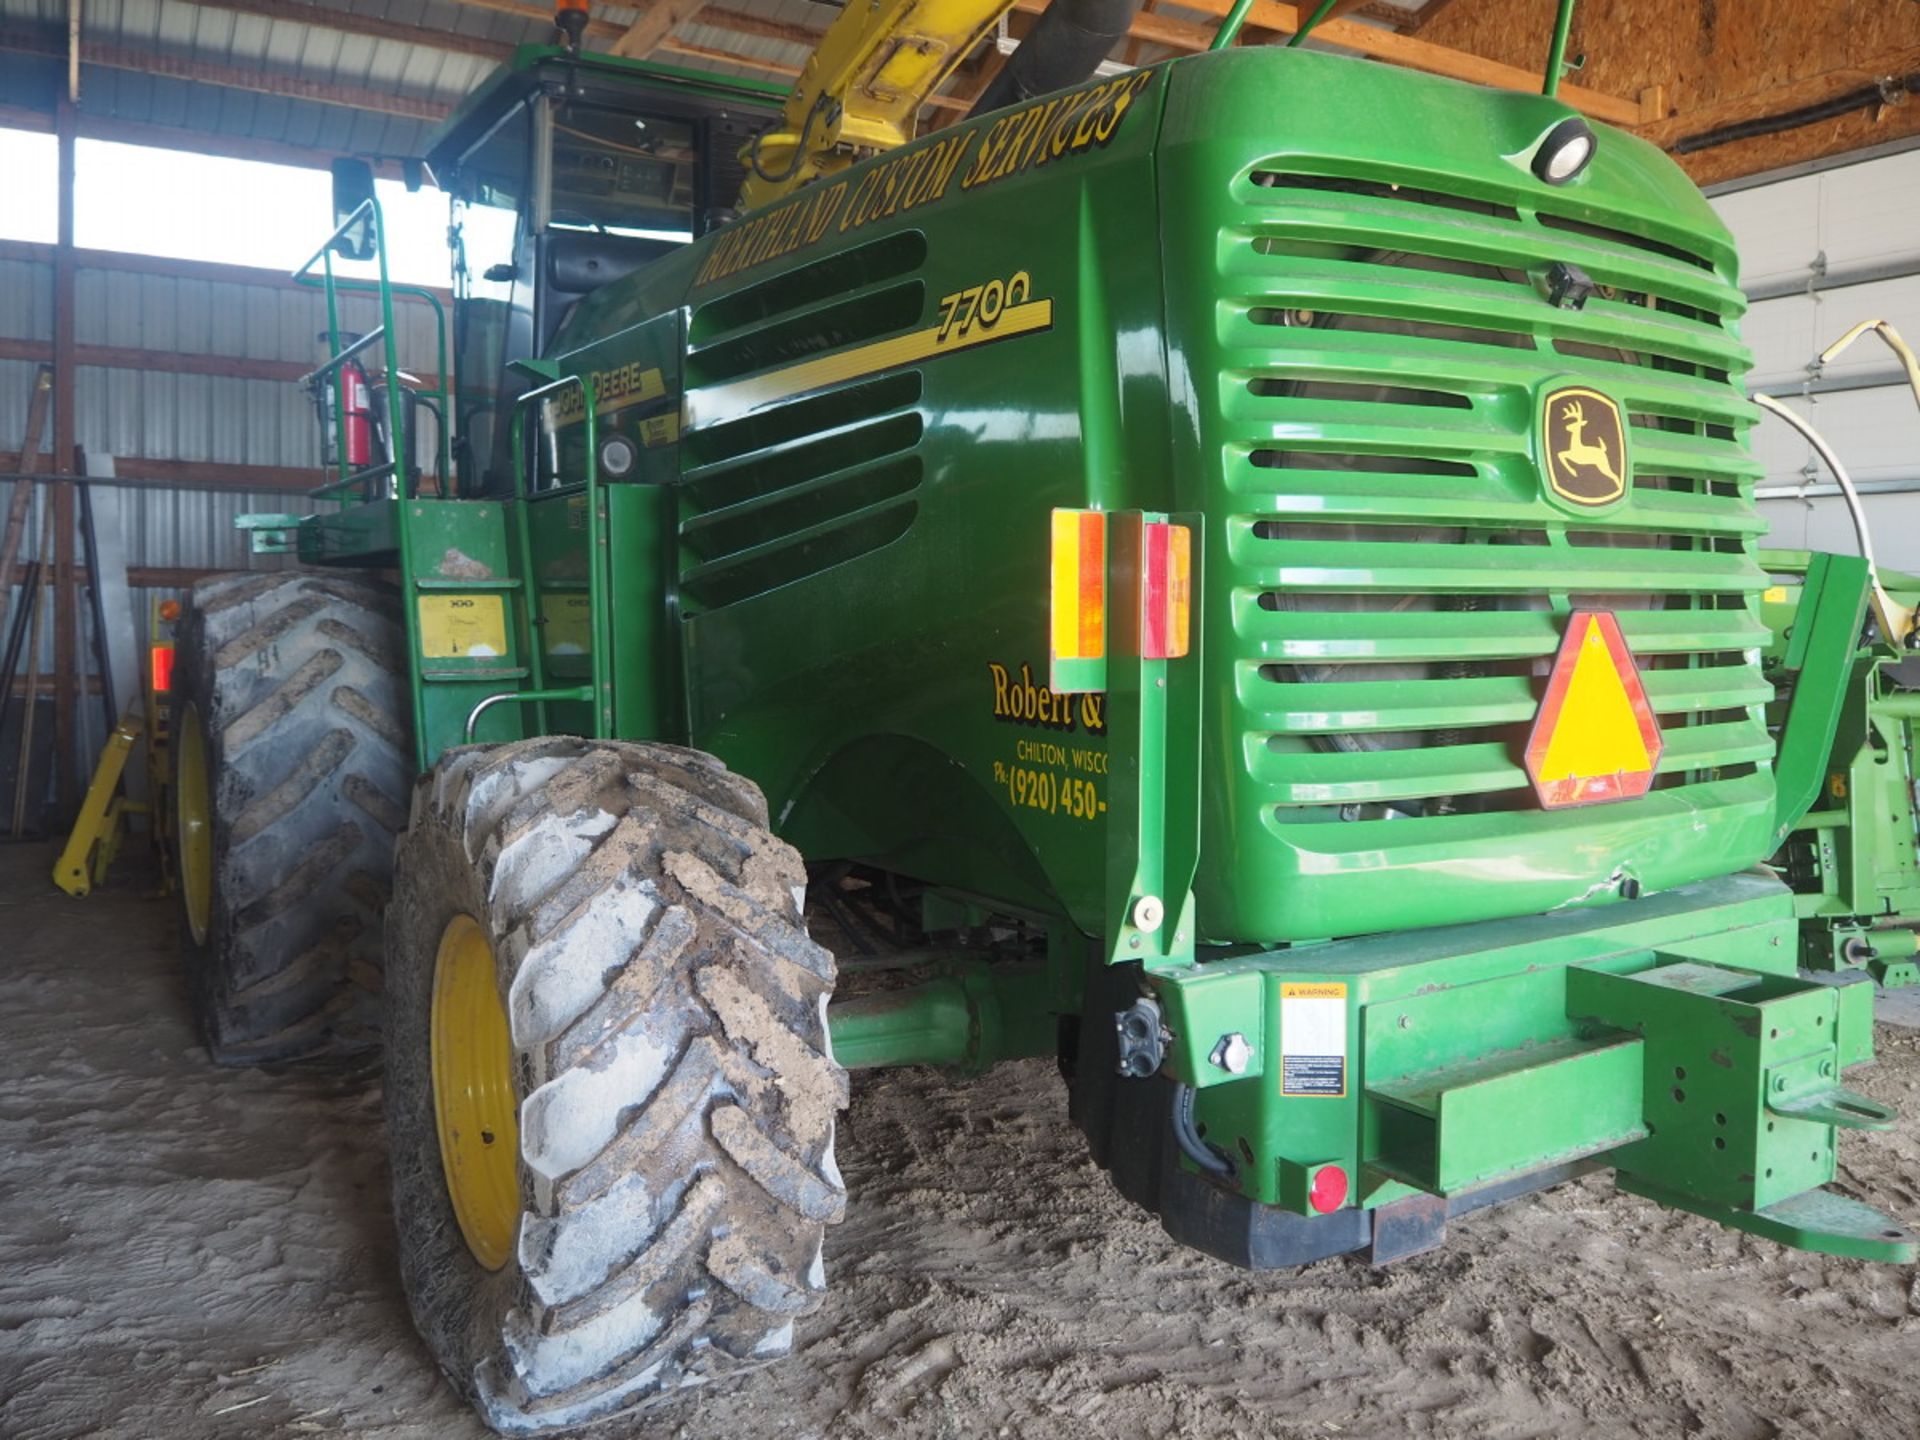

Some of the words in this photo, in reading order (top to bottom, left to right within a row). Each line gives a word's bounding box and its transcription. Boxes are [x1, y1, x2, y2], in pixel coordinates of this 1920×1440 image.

[839, 128, 978, 232] CUSTOM
[960, 70, 1153, 189] SERVICES
[938, 270, 1031, 341] 7700
[592, 361, 641, 403] DEERE
[989, 662, 1072, 726] Robert
[1080, 690, 1104, 730] &
[1017, 739, 1070, 772] CHILTON,
[1010, 765, 1057, 815] (920)
[1298, 988, 1341, 997] WARNING
